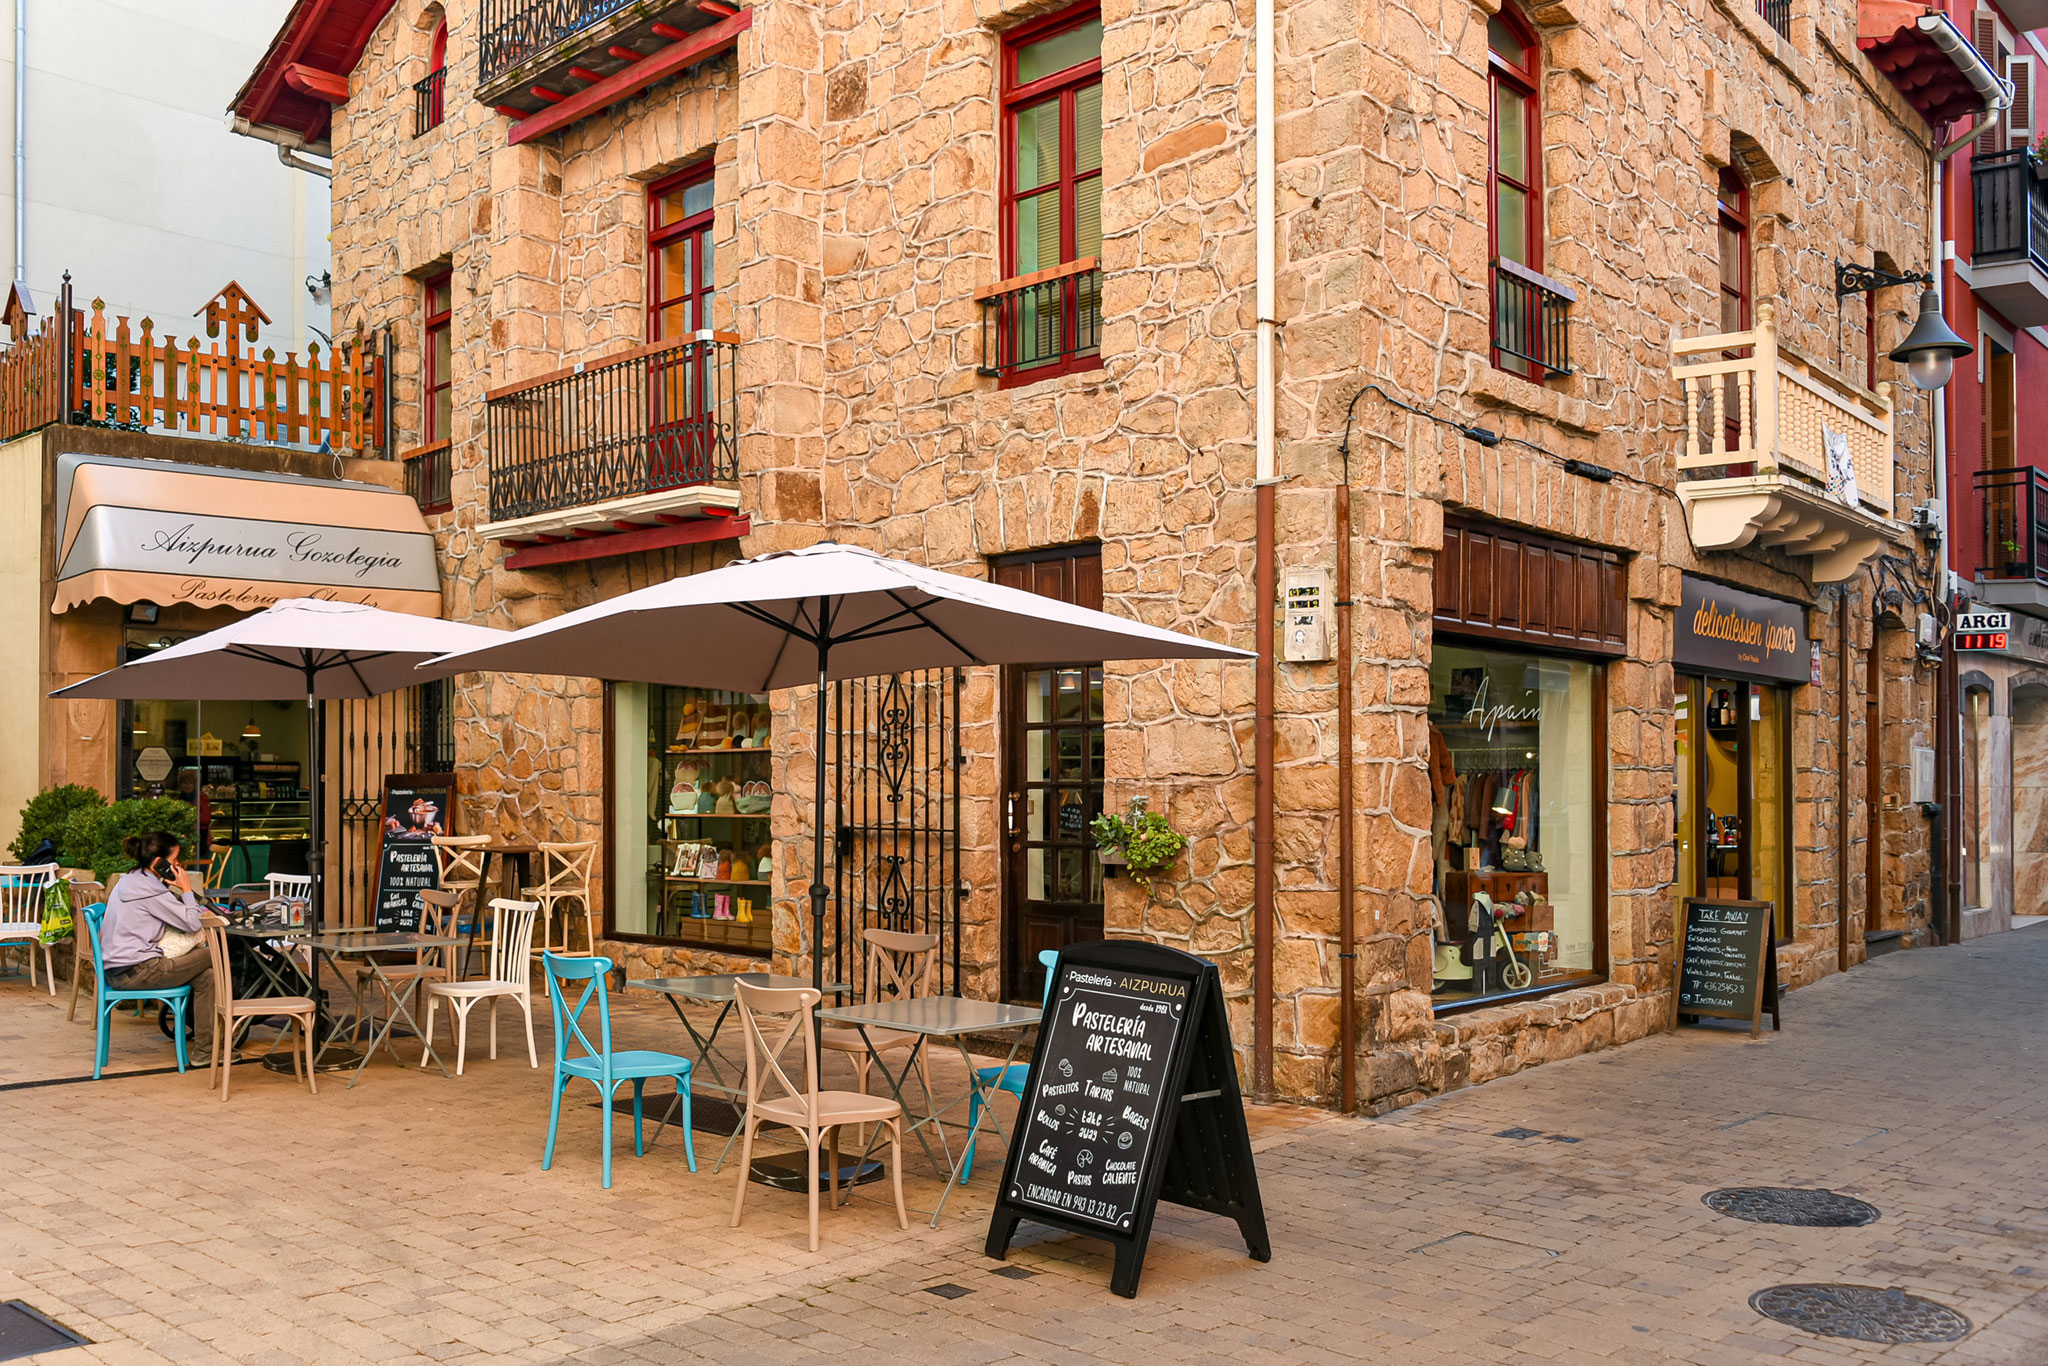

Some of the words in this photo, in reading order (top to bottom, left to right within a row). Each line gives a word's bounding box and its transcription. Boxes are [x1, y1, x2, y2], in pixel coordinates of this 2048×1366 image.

[141, 523, 278, 564] Aizpurua
[286, 531, 403, 578] Gozotegia
[1693, 596, 1763, 647] delicatessen
[1960, 614, 2007, 629] ARGI
[405, 876, 431, 887] NATURAL
[1723, 910, 1750, 922] AWAY
[1069, 970, 1113, 988] Pastelería
[1119, 976, 1187, 999] AIZPURUA
[1085, 1033, 1153, 1062] ARTESANAL
[1126, 1065, 1143, 1079] 100%
[1084, 1079, 1115, 1103] TARTAS
[1122, 1079, 1151, 1097] NATURAL
[1037, 1109, 1061, 1132] BOLLOS
[1122, 1104, 1150, 1131] BAGELS
[1102, 1171, 1138, 1185] CALIENTE
[1026, 1183, 1062, 1205] ENCARGAR
[1061, 1192, 1073, 1209] EN
[1072, 1193, 1087, 1212] 943
[1087, 1199, 1096, 1215] 13
[1095, 1201, 1107, 1217] 23
[1106, 1204, 1118, 1220] 82
